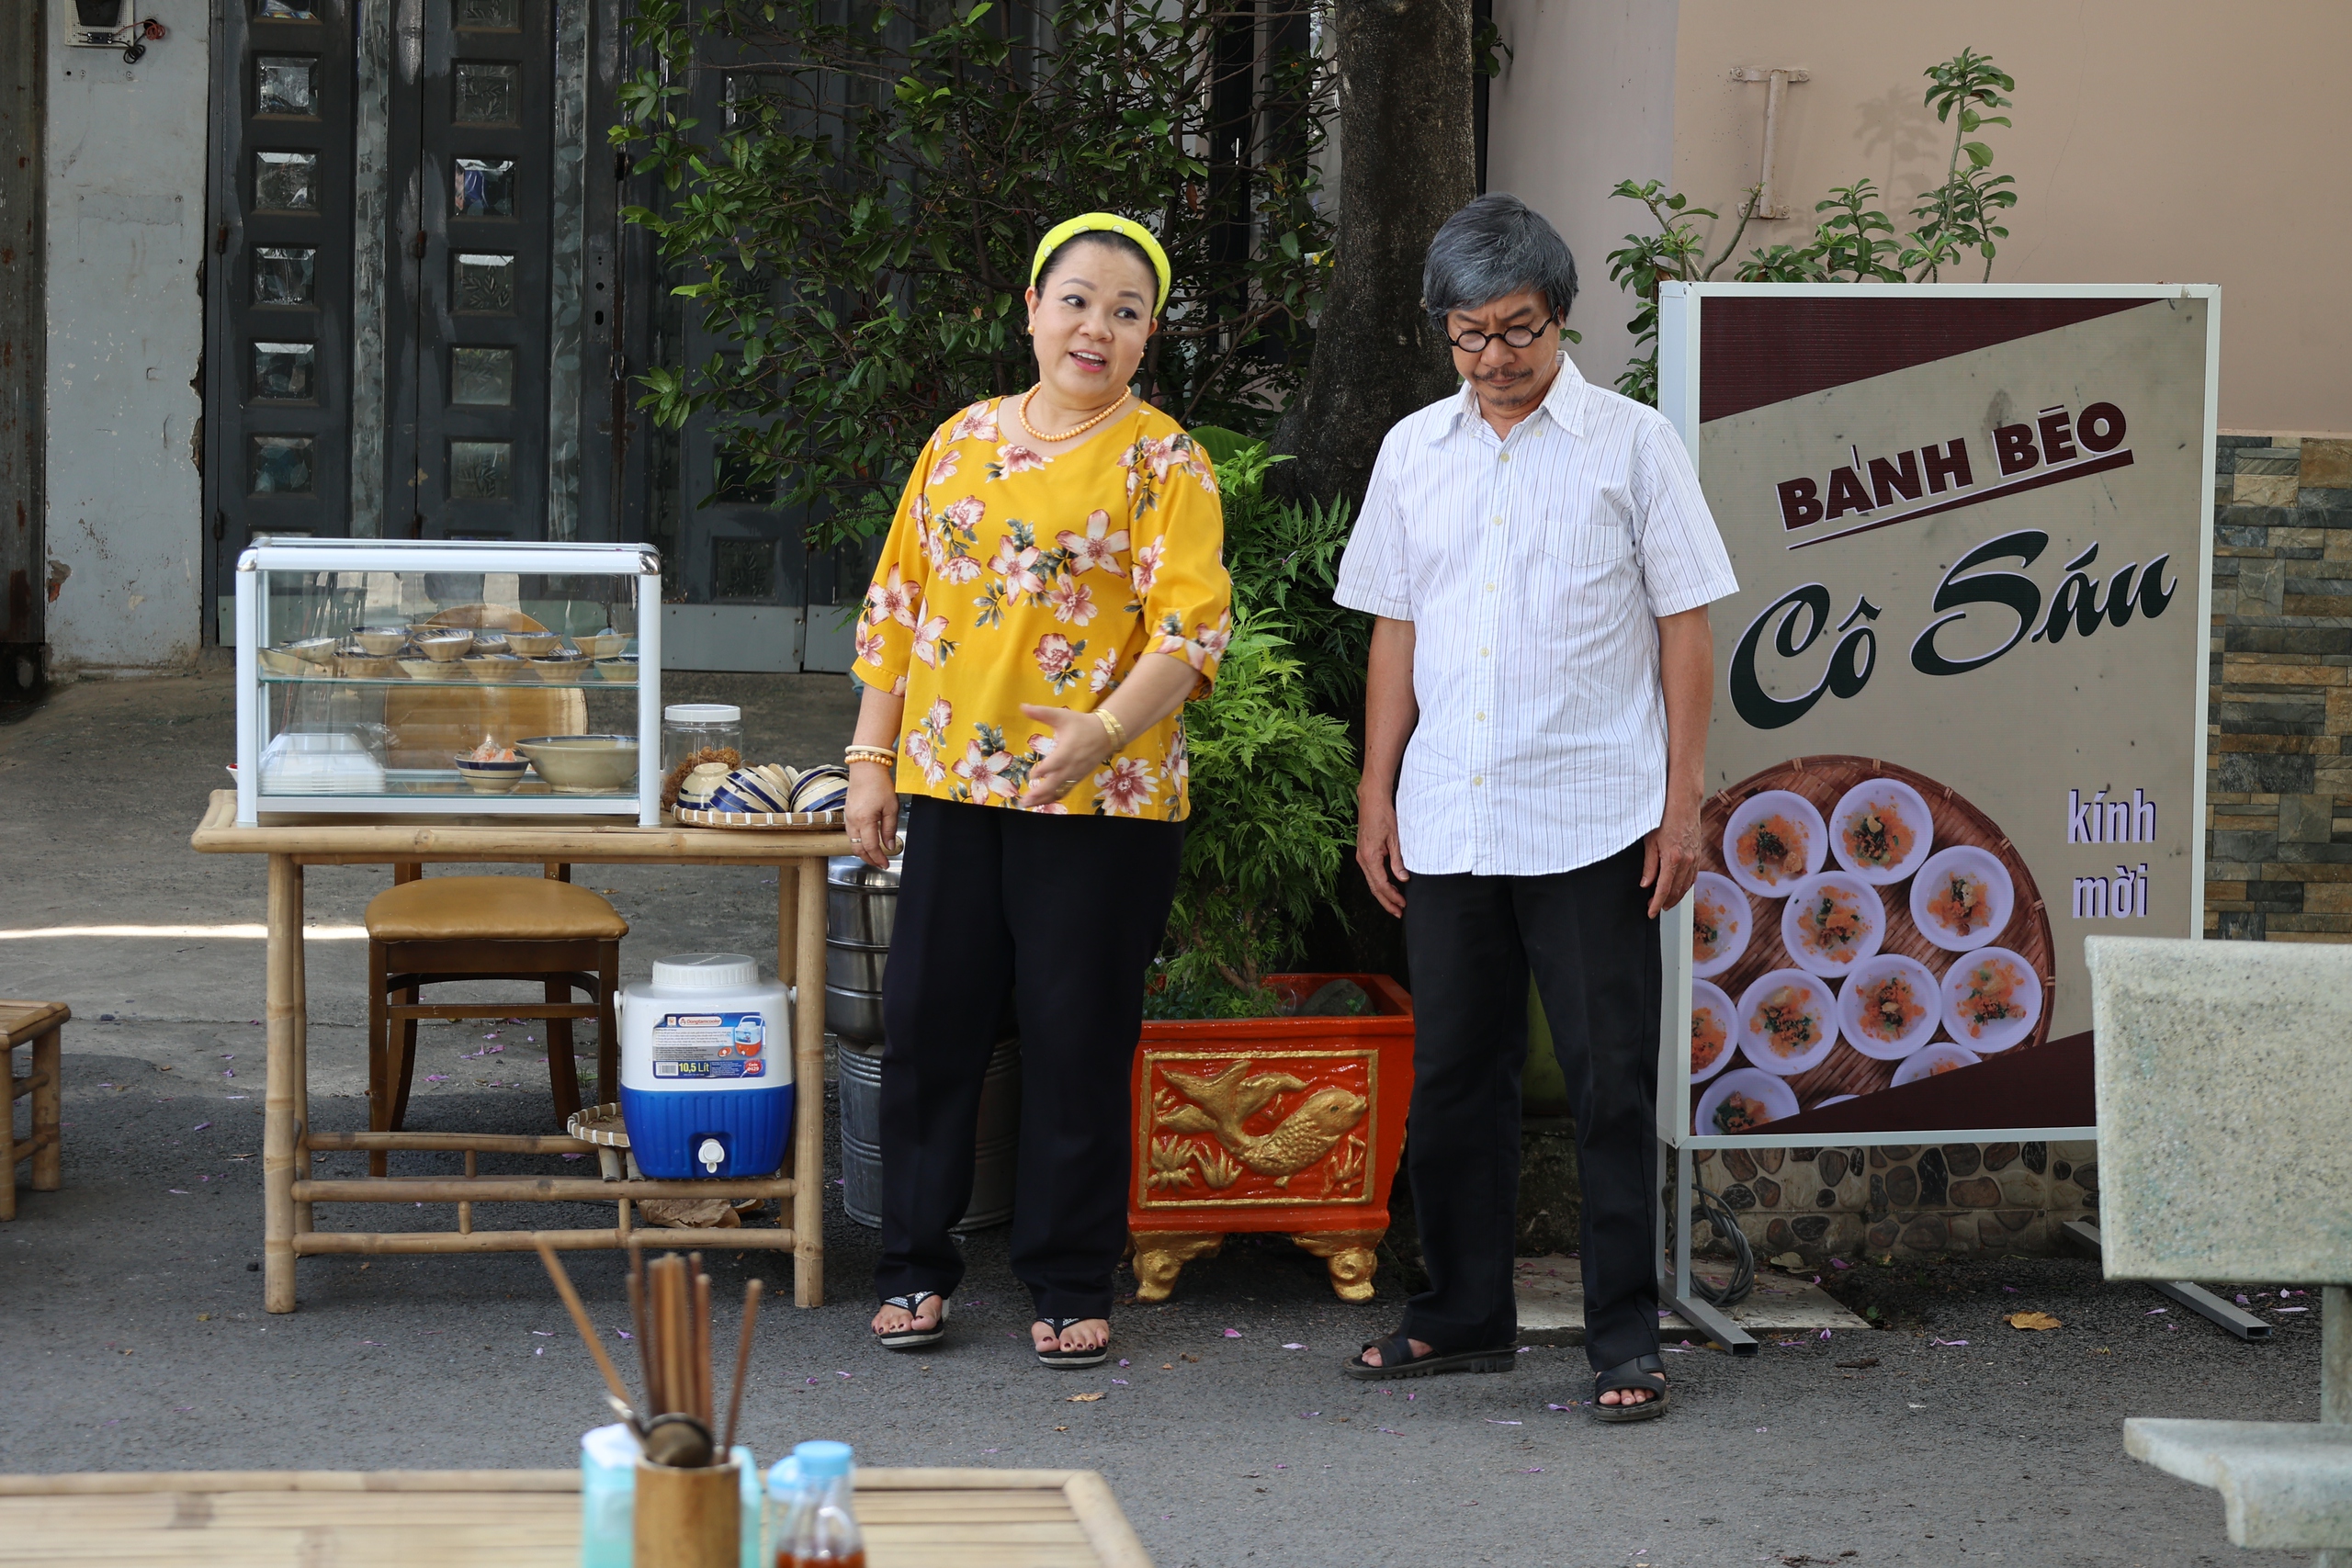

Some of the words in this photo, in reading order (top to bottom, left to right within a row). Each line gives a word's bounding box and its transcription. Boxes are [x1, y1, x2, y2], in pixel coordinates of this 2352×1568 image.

[1728, 581, 1882, 729] Cô
[1910, 528, 2178, 676] Sáu
[2067, 788, 2156, 844] kính
[2073, 863, 2148, 919] mời
[678, 1062, 696, 1074] 10,5
